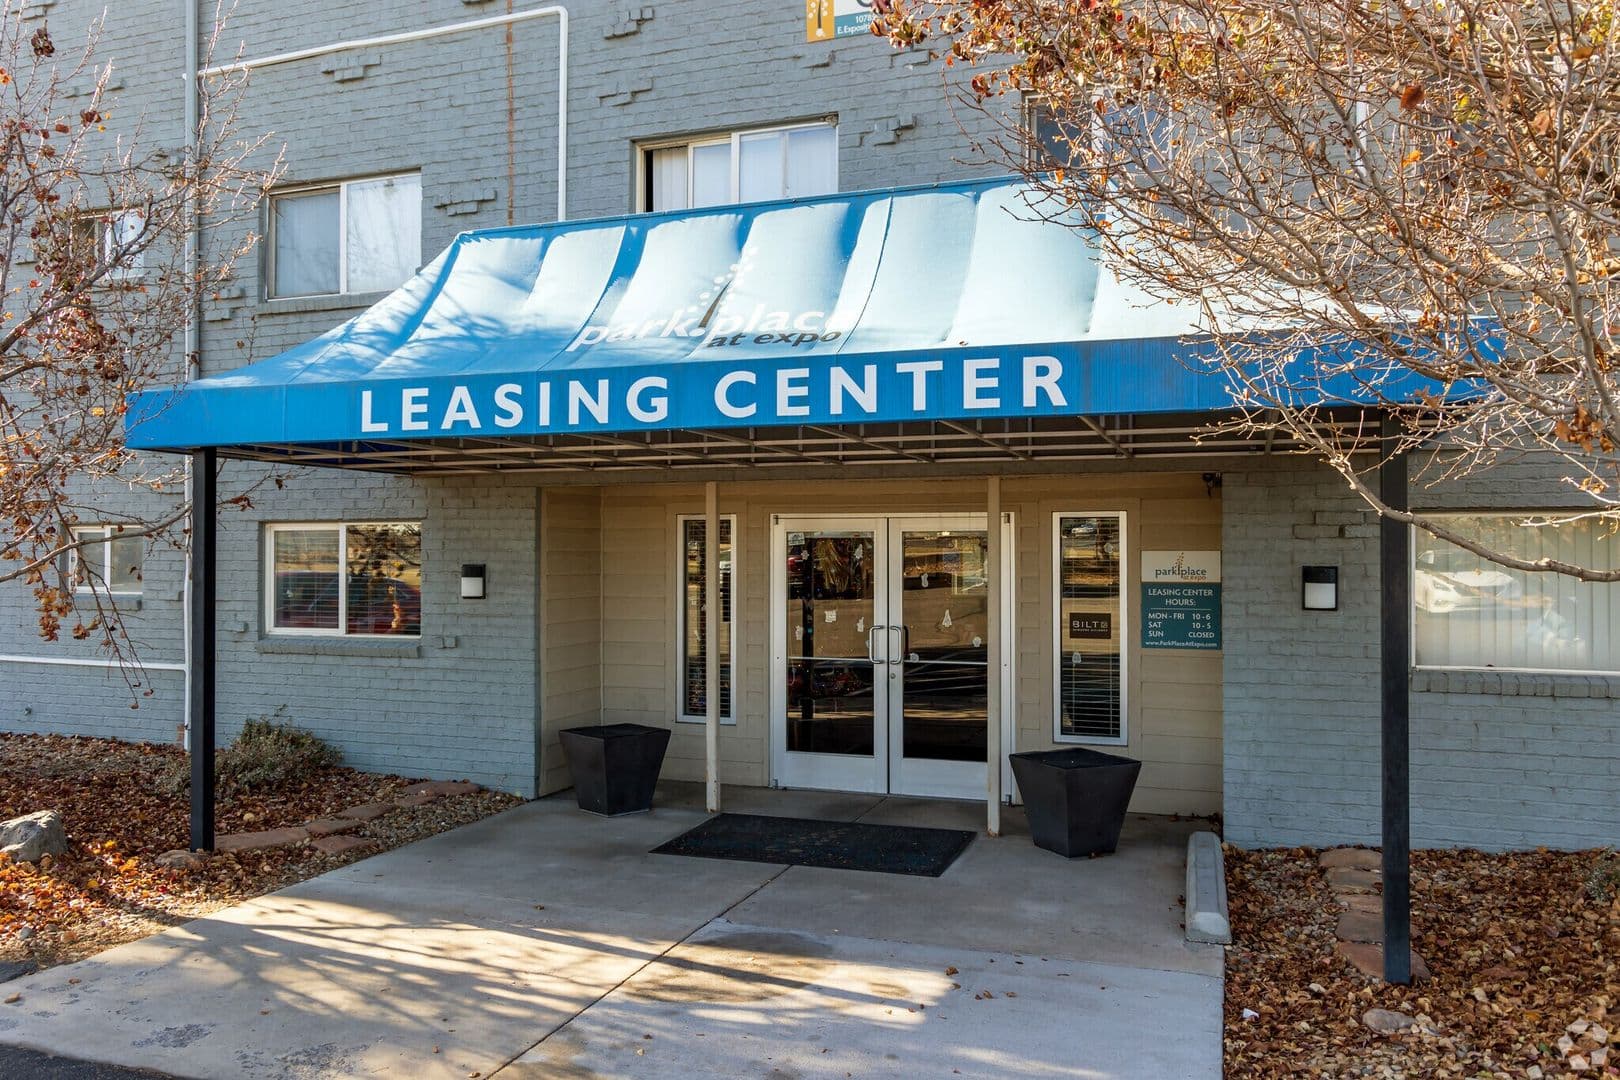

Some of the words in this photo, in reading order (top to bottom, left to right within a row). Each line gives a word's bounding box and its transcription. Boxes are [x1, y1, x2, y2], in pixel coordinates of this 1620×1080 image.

[565, 308, 693, 352] park
[706, 331, 747, 348] at
[753, 330, 841, 347] expo
[361, 376, 669, 433] LEASING
[714, 355, 1068, 418] CENTER
[1155, 565, 1177, 579] park
[1180, 565, 1207, 579] place
[1148, 588, 1181, 596] LEASING
[1173, 612, 1185, 620] FRI
[1072, 620, 1099, 628] BILT
[1148, 621, 1162, 629] SAT
